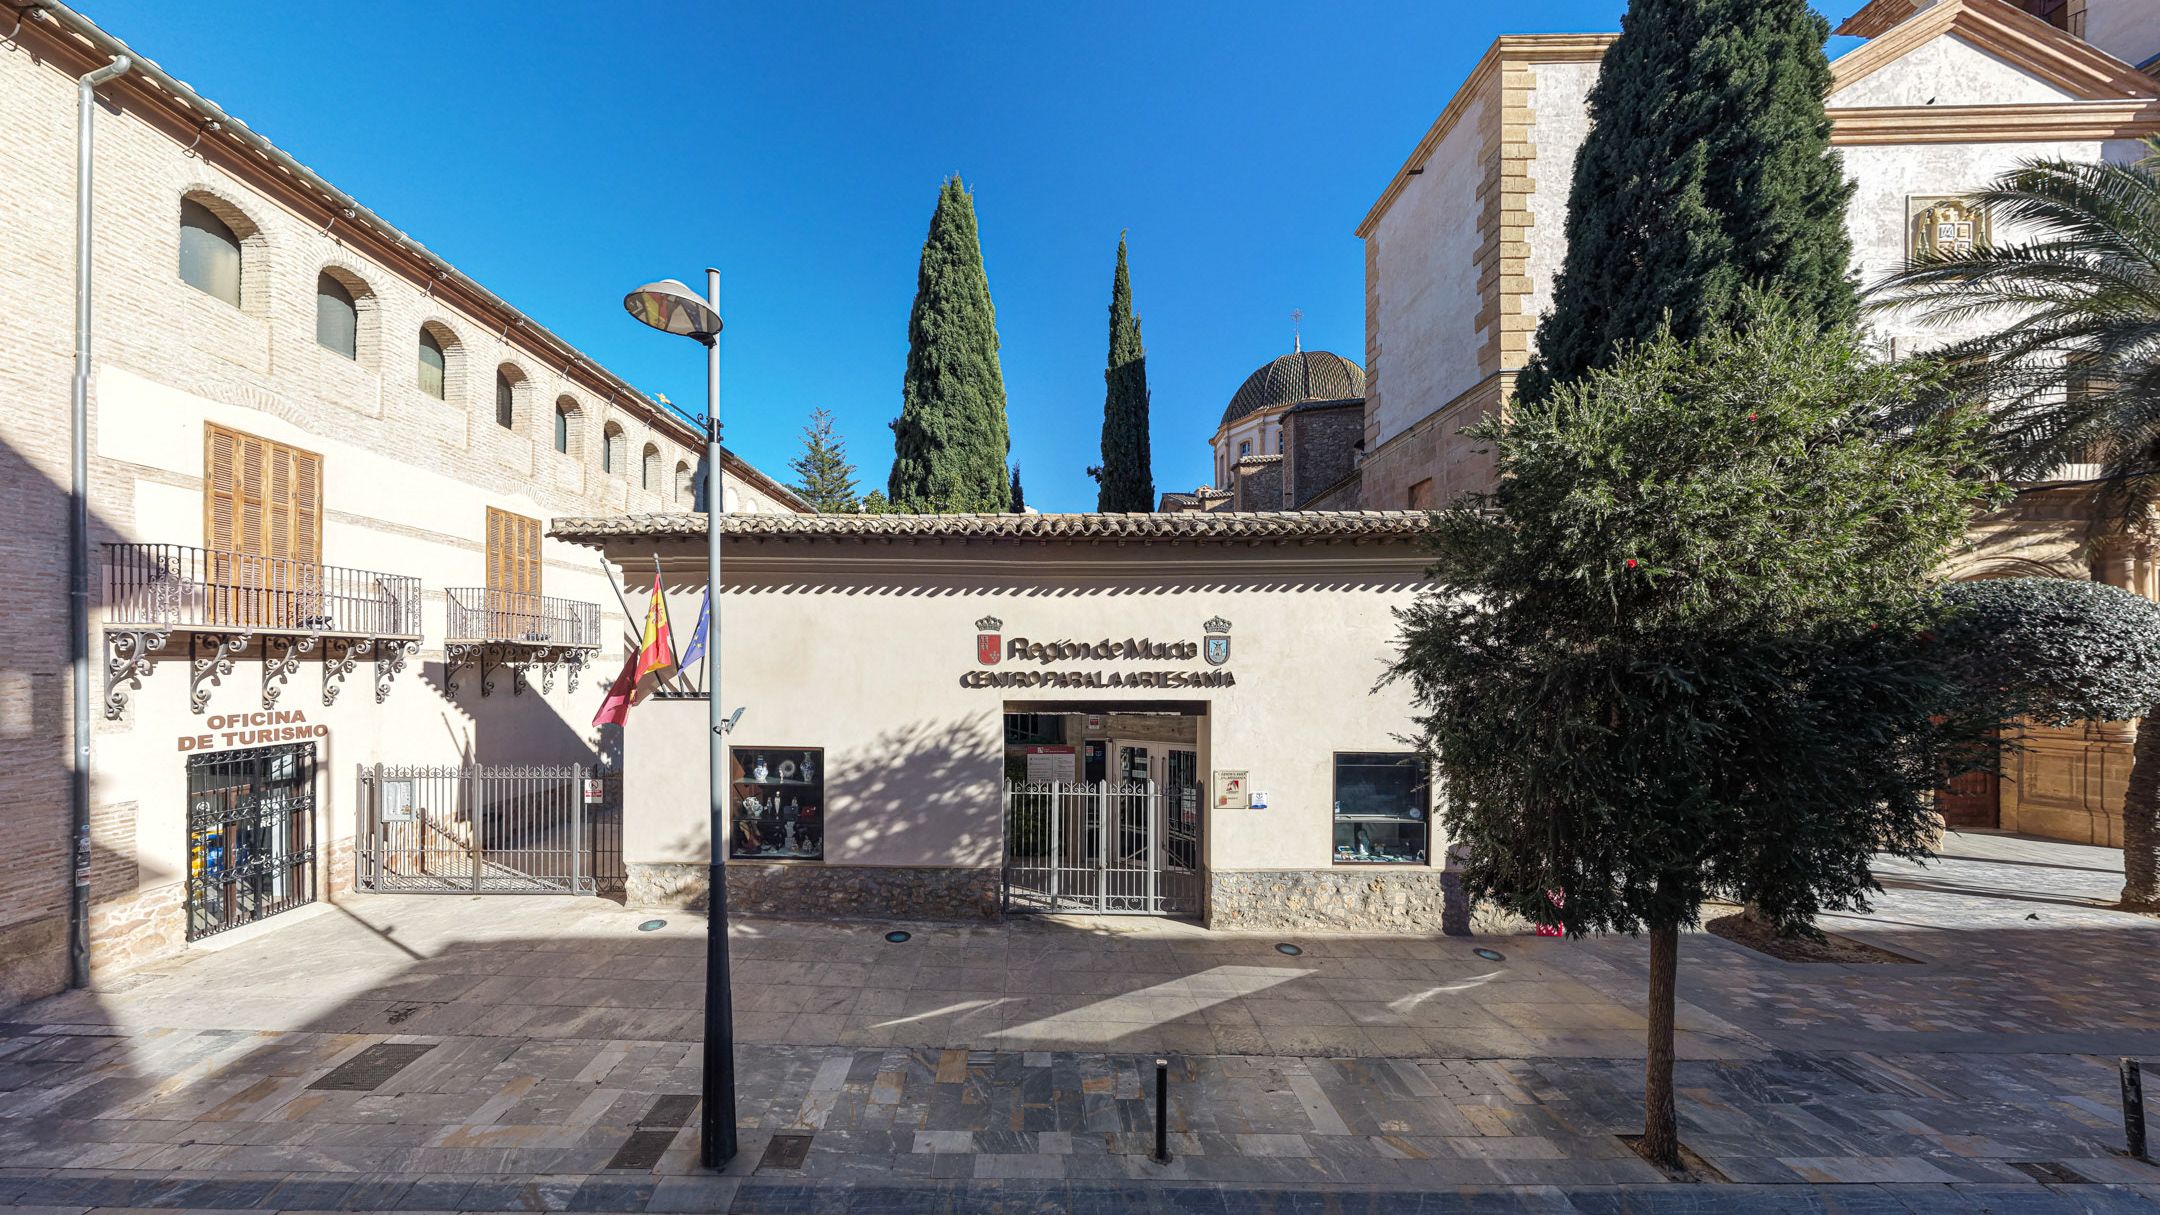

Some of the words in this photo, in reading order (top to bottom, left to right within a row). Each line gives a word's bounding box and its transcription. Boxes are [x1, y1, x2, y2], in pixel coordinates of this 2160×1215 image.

[1123, 637, 1198, 661] Murcia
[959, 670, 1041, 689] CENTRO
[1039, 671, 1096, 689] PARA
[1092, 670, 1123, 689] LA
[207, 709, 307, 730] OFICINA
[177, 734, 214, 752] DE
[221, 724, 329, 747] TURISMO
